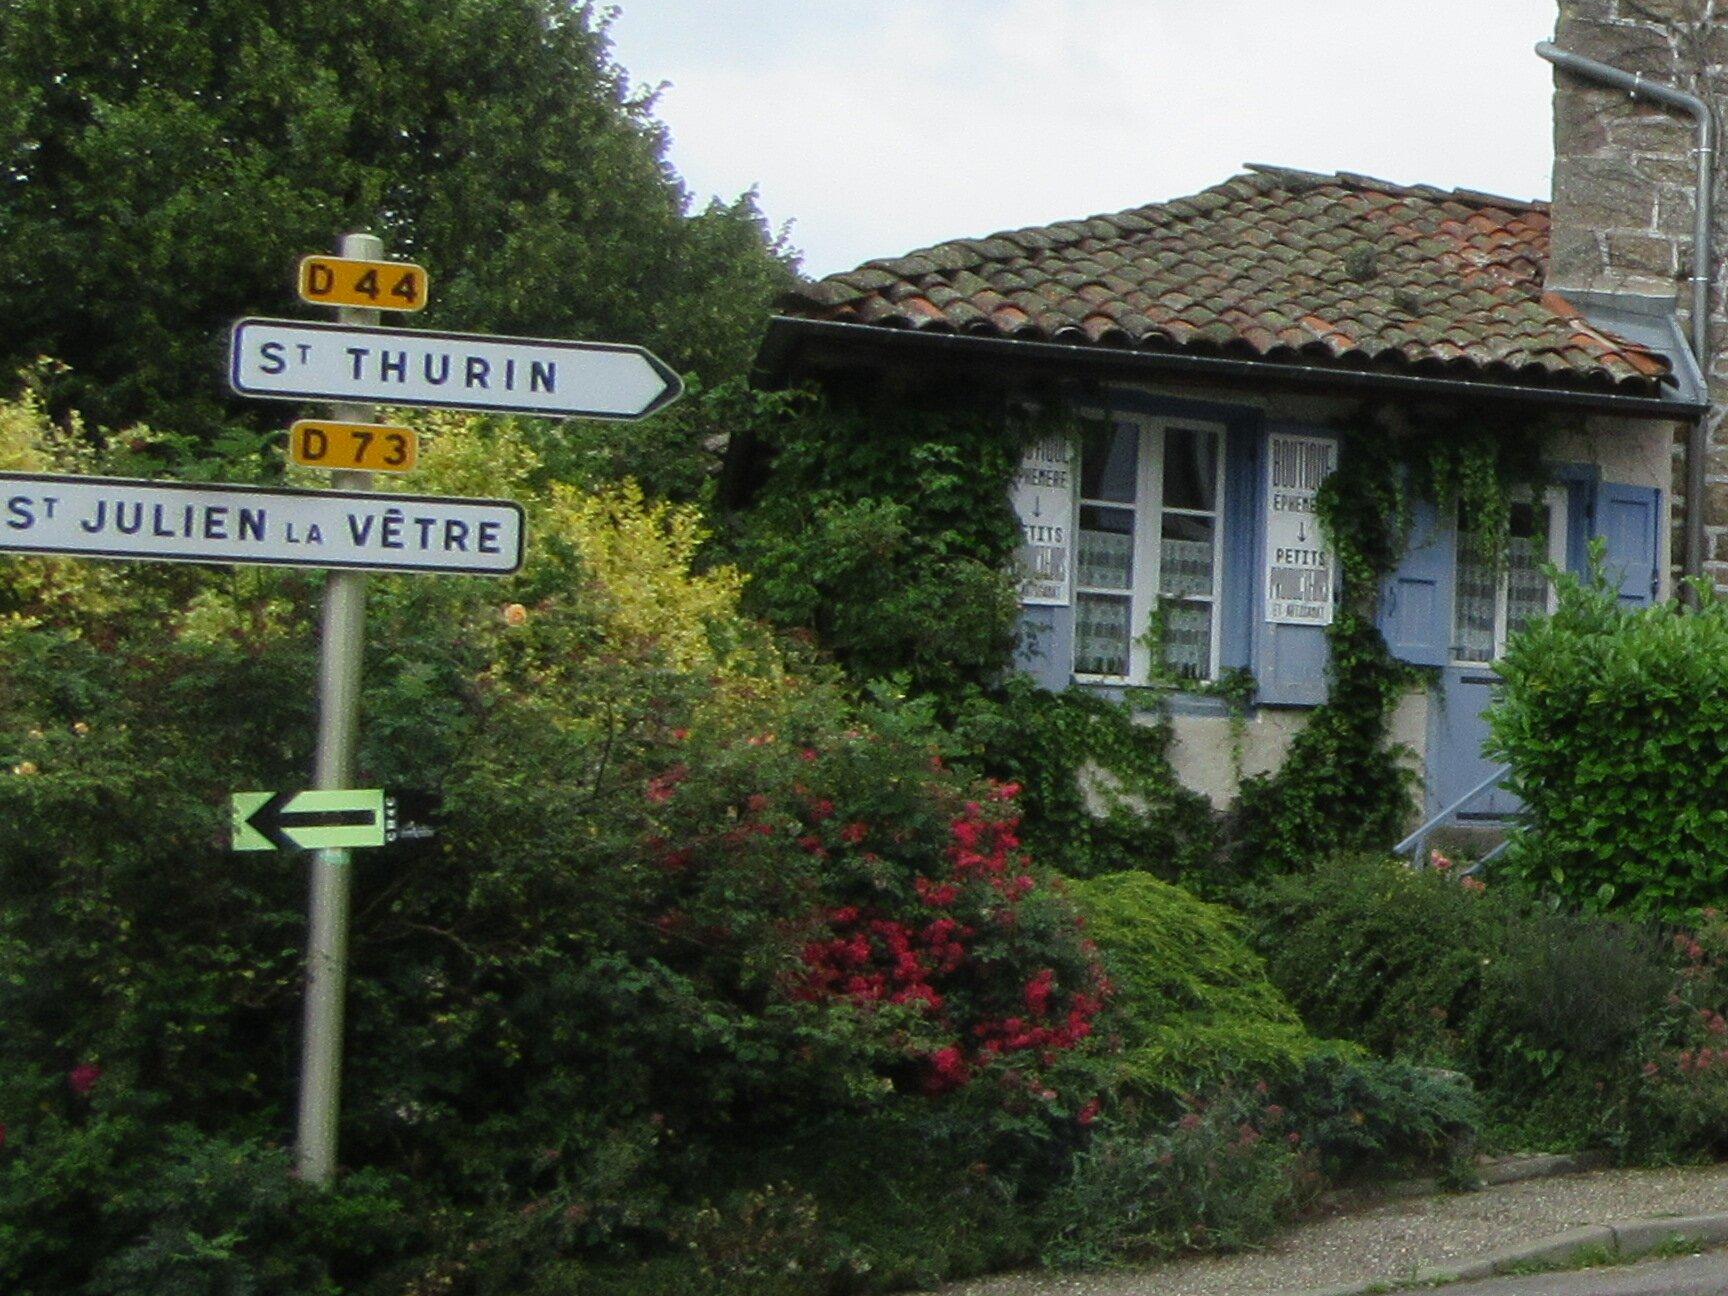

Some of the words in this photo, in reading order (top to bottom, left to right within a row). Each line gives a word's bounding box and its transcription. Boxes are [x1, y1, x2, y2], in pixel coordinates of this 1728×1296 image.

[307, 263, 335, 296] D
[353, 268, 418, 304] 44
[258, 341, 313, 375] ST
[346, 346, 558, 394] THURIN
[301, 427, 329, 461] D
[351, 431, 409, 467] 73
[6, 495, 61, 530] ST
[80, 499, 267, 542] JULIEN
[285, 521, 324, 545] LA
[347, 507, 502, 554] VÊTRE
[1025, 525, 1064, 544] TITS
[1276, 547, 1326, 566] PETITS
